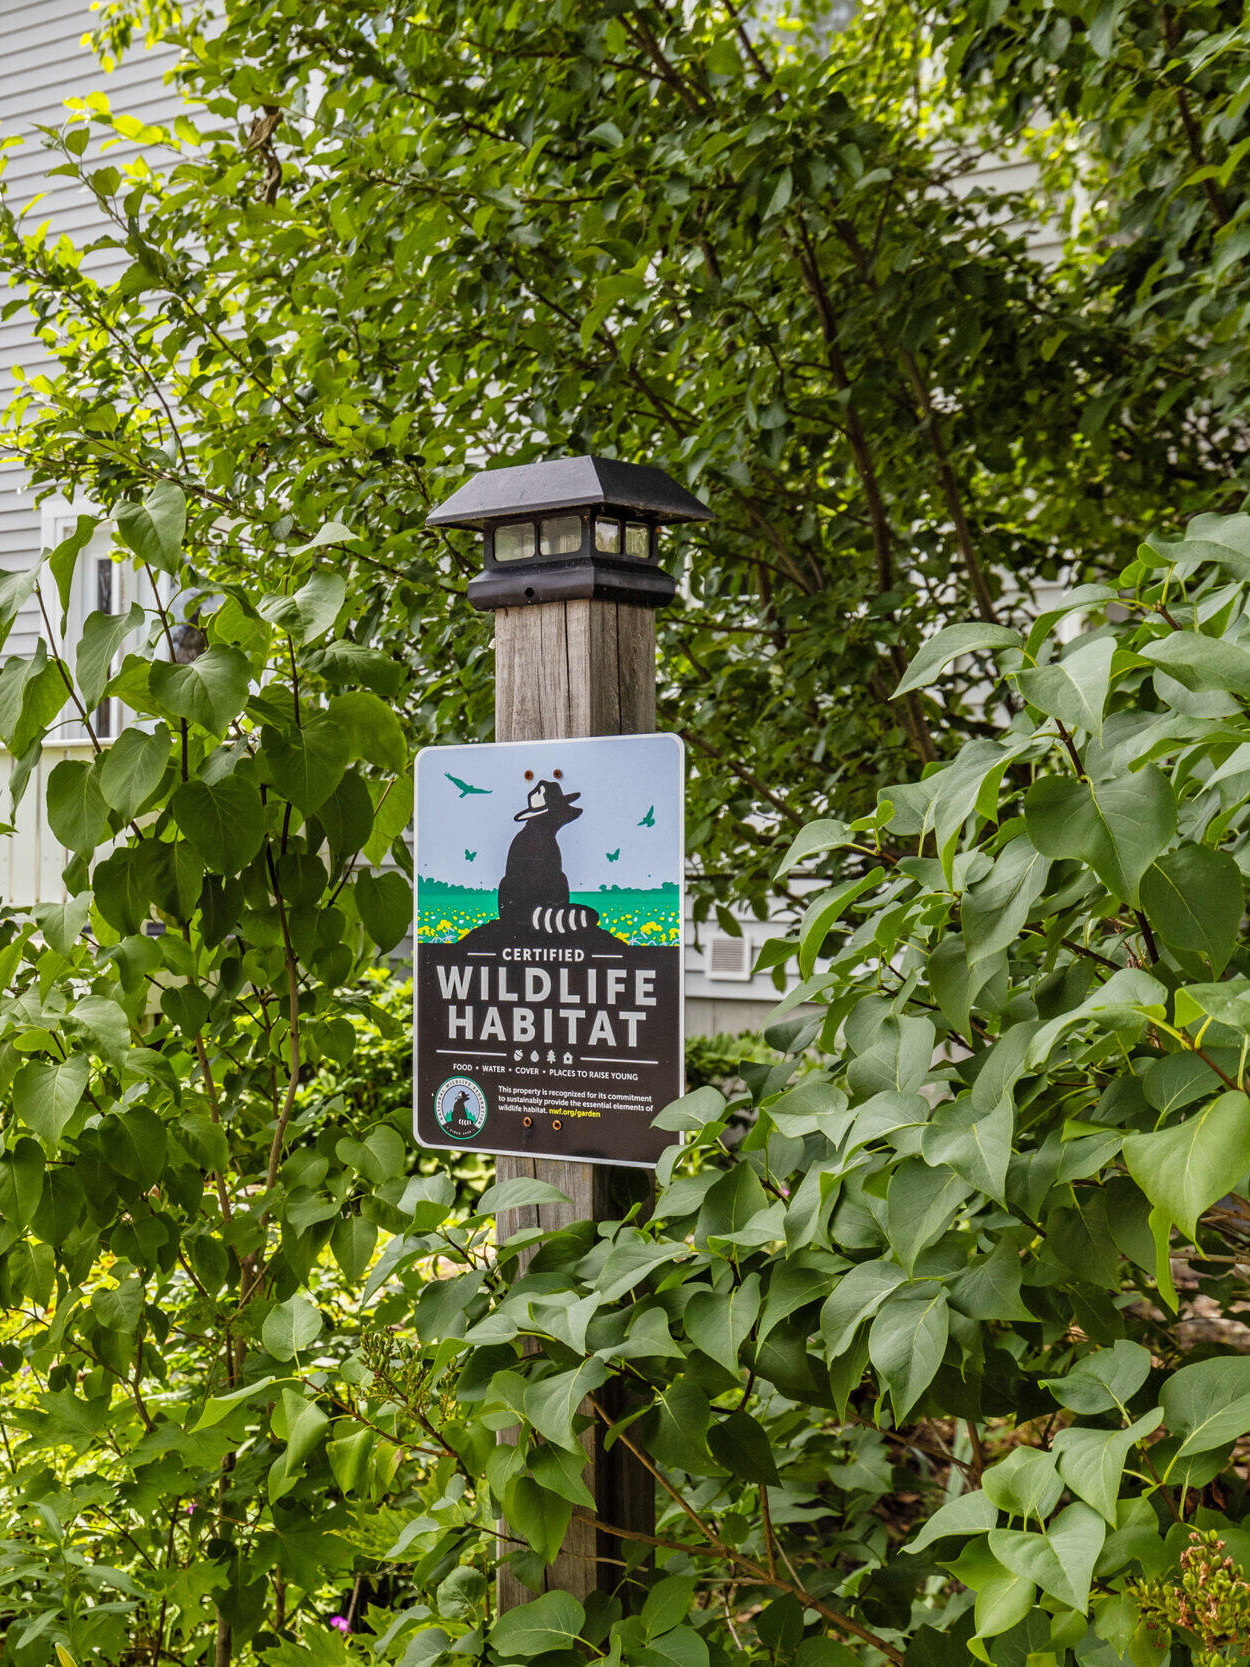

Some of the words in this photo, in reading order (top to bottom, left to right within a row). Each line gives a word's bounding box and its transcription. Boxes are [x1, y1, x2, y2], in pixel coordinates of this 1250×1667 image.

[502, 948, 585, 962] CERTIFIED
[436, 965, 657, 1006] WILDLIFE
[448, 1005, 647, 1047] HABITAT
[453, 1063, 473, 1071] FOOD
[482, 1065, 506, 1073] WATER
[515, 1067, 539, 1075] COVER
[549, 1069, 576, 1077] PLACES
[577, 1070, 588, 1078] TO
[589, 1071, 610, 1079] RAISE
[611, 1072, 639, 1081] YOUNG
[498, 1085, 511, 1093] This
[513, 1087, 541, 1096] property
[542, 1088, 548, 1096] is
[549, 1090, 586, 1098] recognized
[587, 1091, 597, 1099] for
[598, 1092, 607, 1100] its
[608, 1093, 652, 1102] commitment
[498, 1104, 522, 1112] wildlife
[523, 1105, 548, 1114] habitat.
[549, 1108, 601, 1118] nwf.org/garden
[506, 1096, 542, 1105] sustainably
[543, 1099, 569, 1107] provide
[582, 1101, 612, 1109] essential
[613, 1102, 645, 1111] elements
